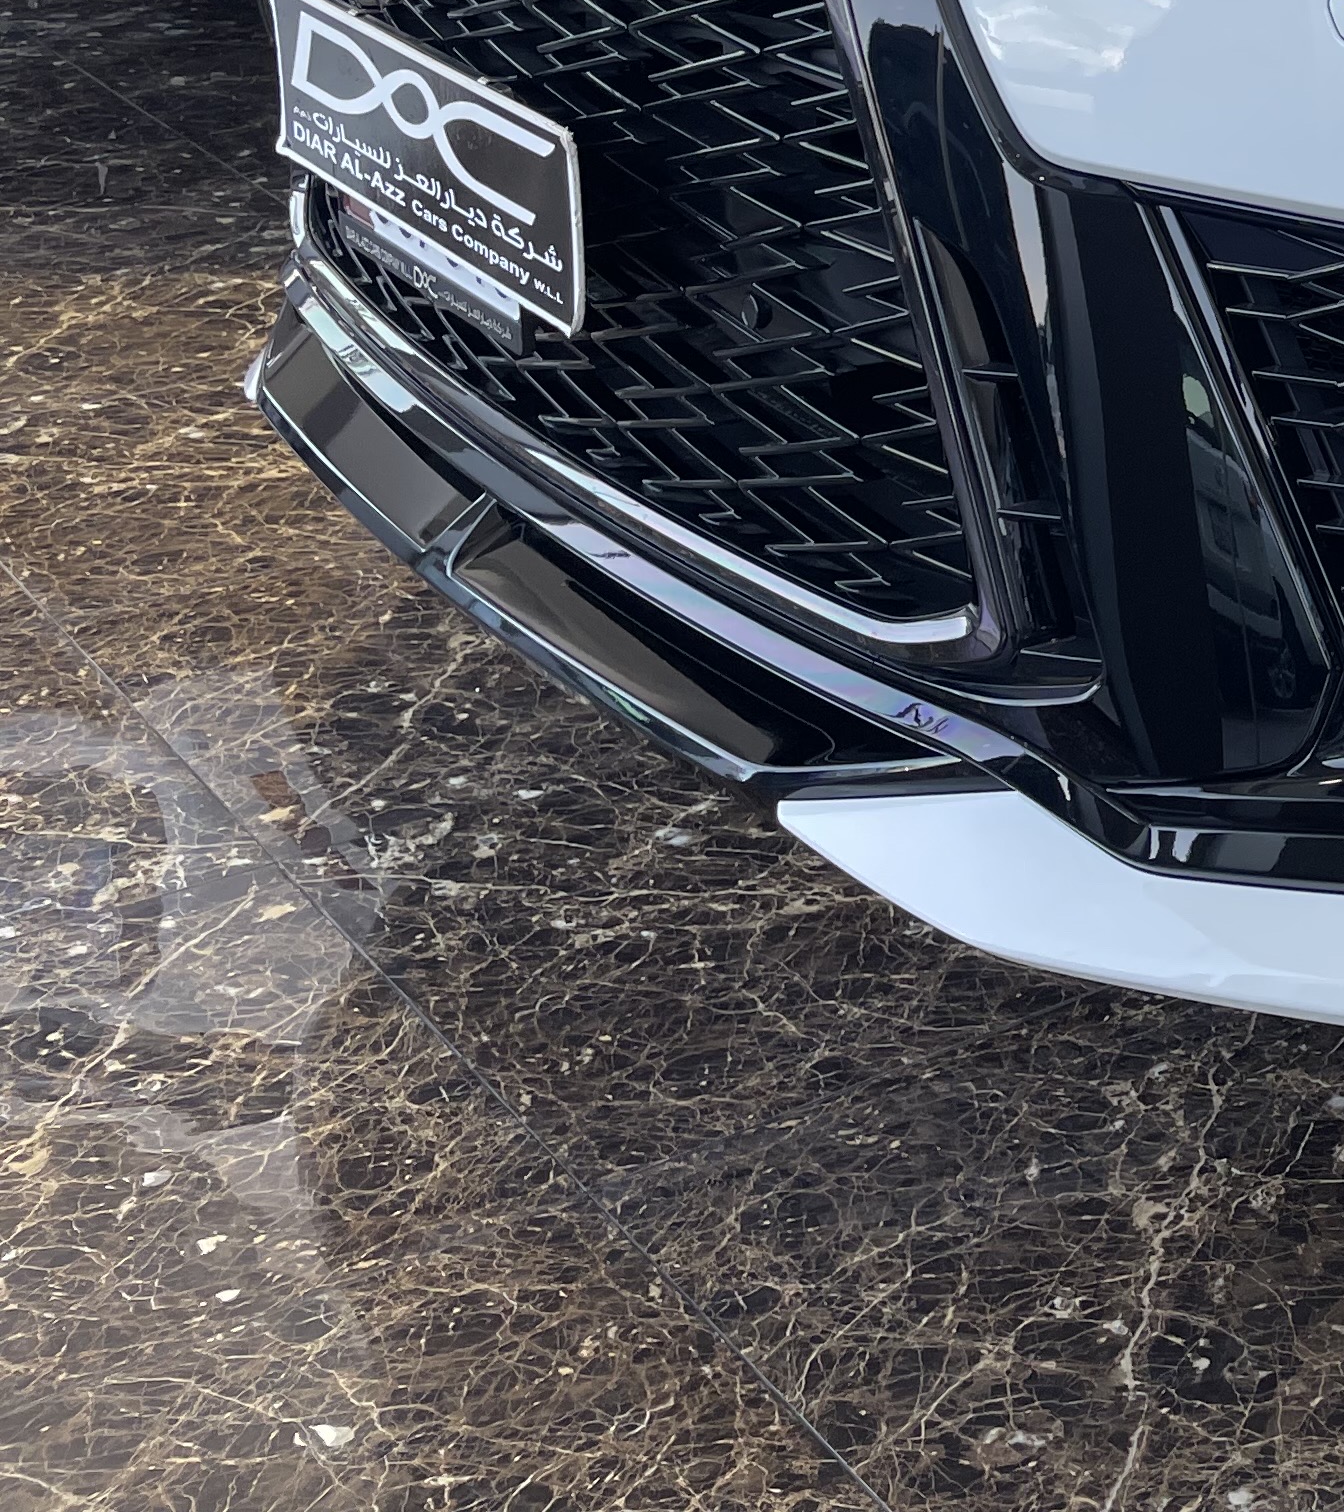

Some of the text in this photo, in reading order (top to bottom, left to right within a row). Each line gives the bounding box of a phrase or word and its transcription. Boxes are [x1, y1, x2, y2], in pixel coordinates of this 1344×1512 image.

[313, 112, 391, 169] للسيارات
[293, 120, 337, 165] DIAR
[411, 199, 448, 232] Cars
[451, 224, 530, 285] Company
[394, 157, 441, 200] العز
[440, 188, 488, 229] ديار
[491, 213, 563, 272] شركة
